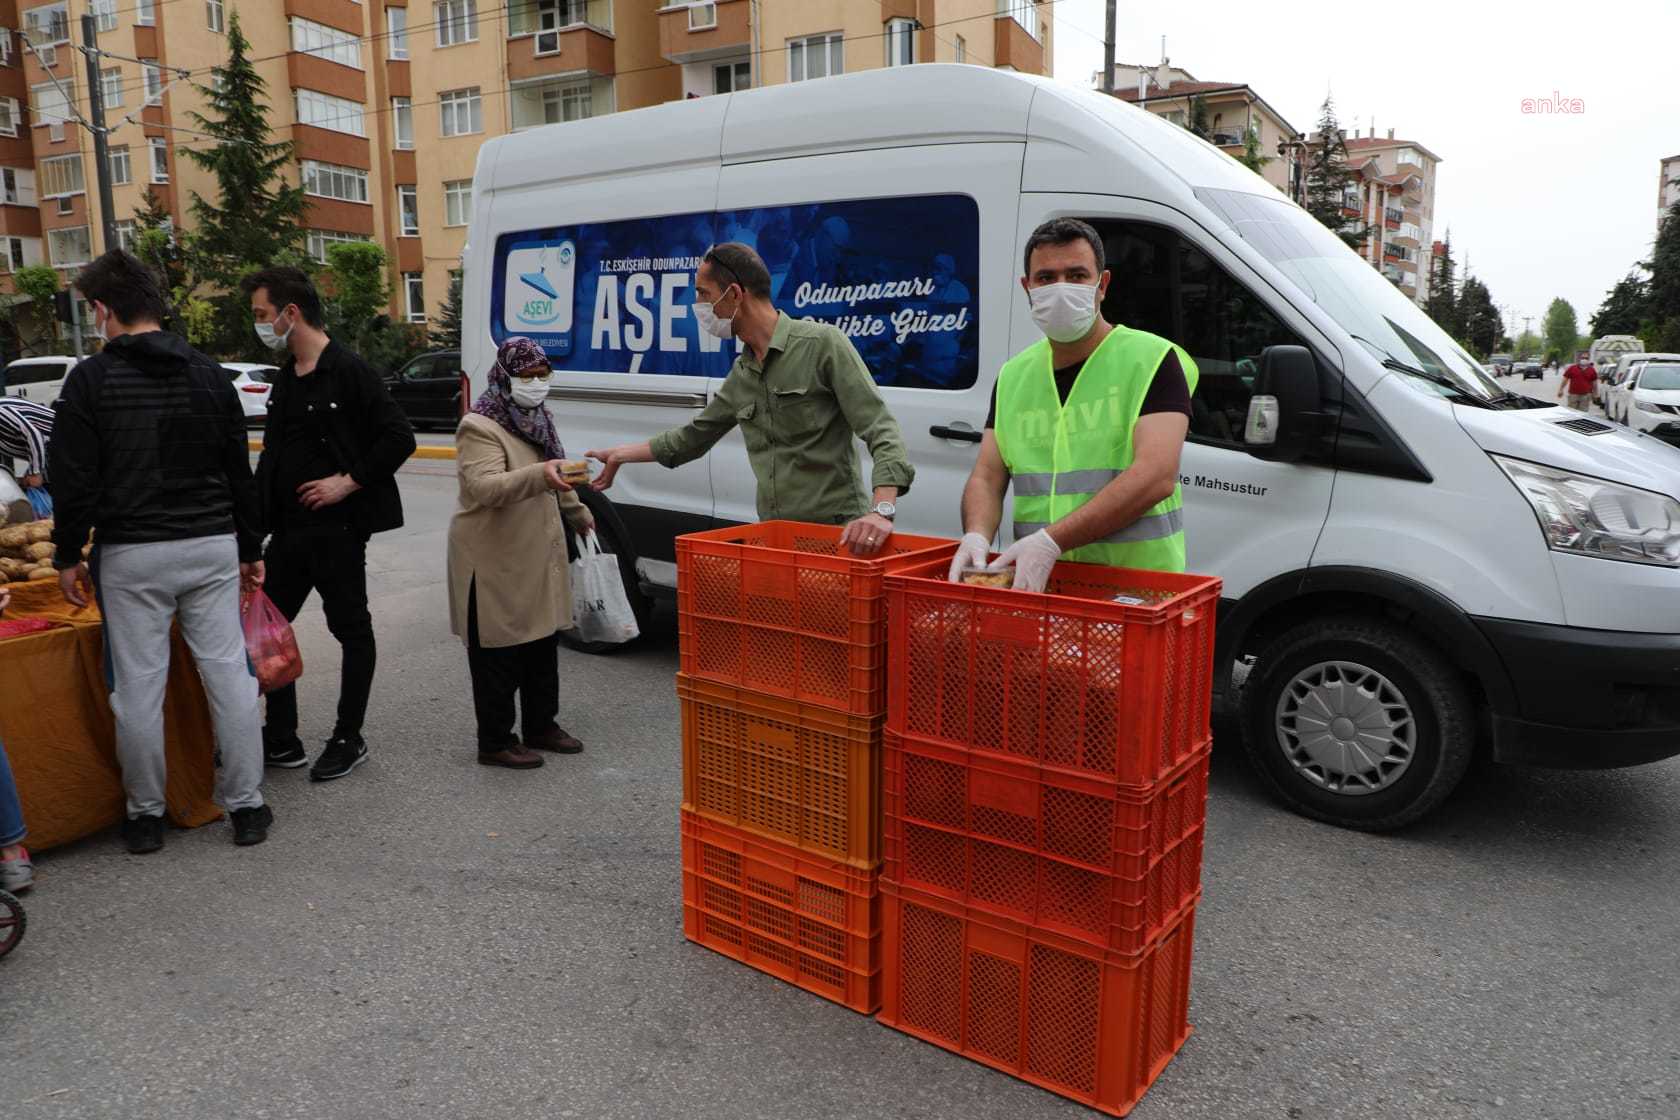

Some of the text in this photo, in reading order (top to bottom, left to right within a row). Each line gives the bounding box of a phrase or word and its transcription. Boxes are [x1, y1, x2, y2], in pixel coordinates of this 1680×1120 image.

[794, 276, 935, 308] Odunpazarı
[890, 307, 968, 345] Güzel
[1194, 475, 1268, 497] Mahsustur
